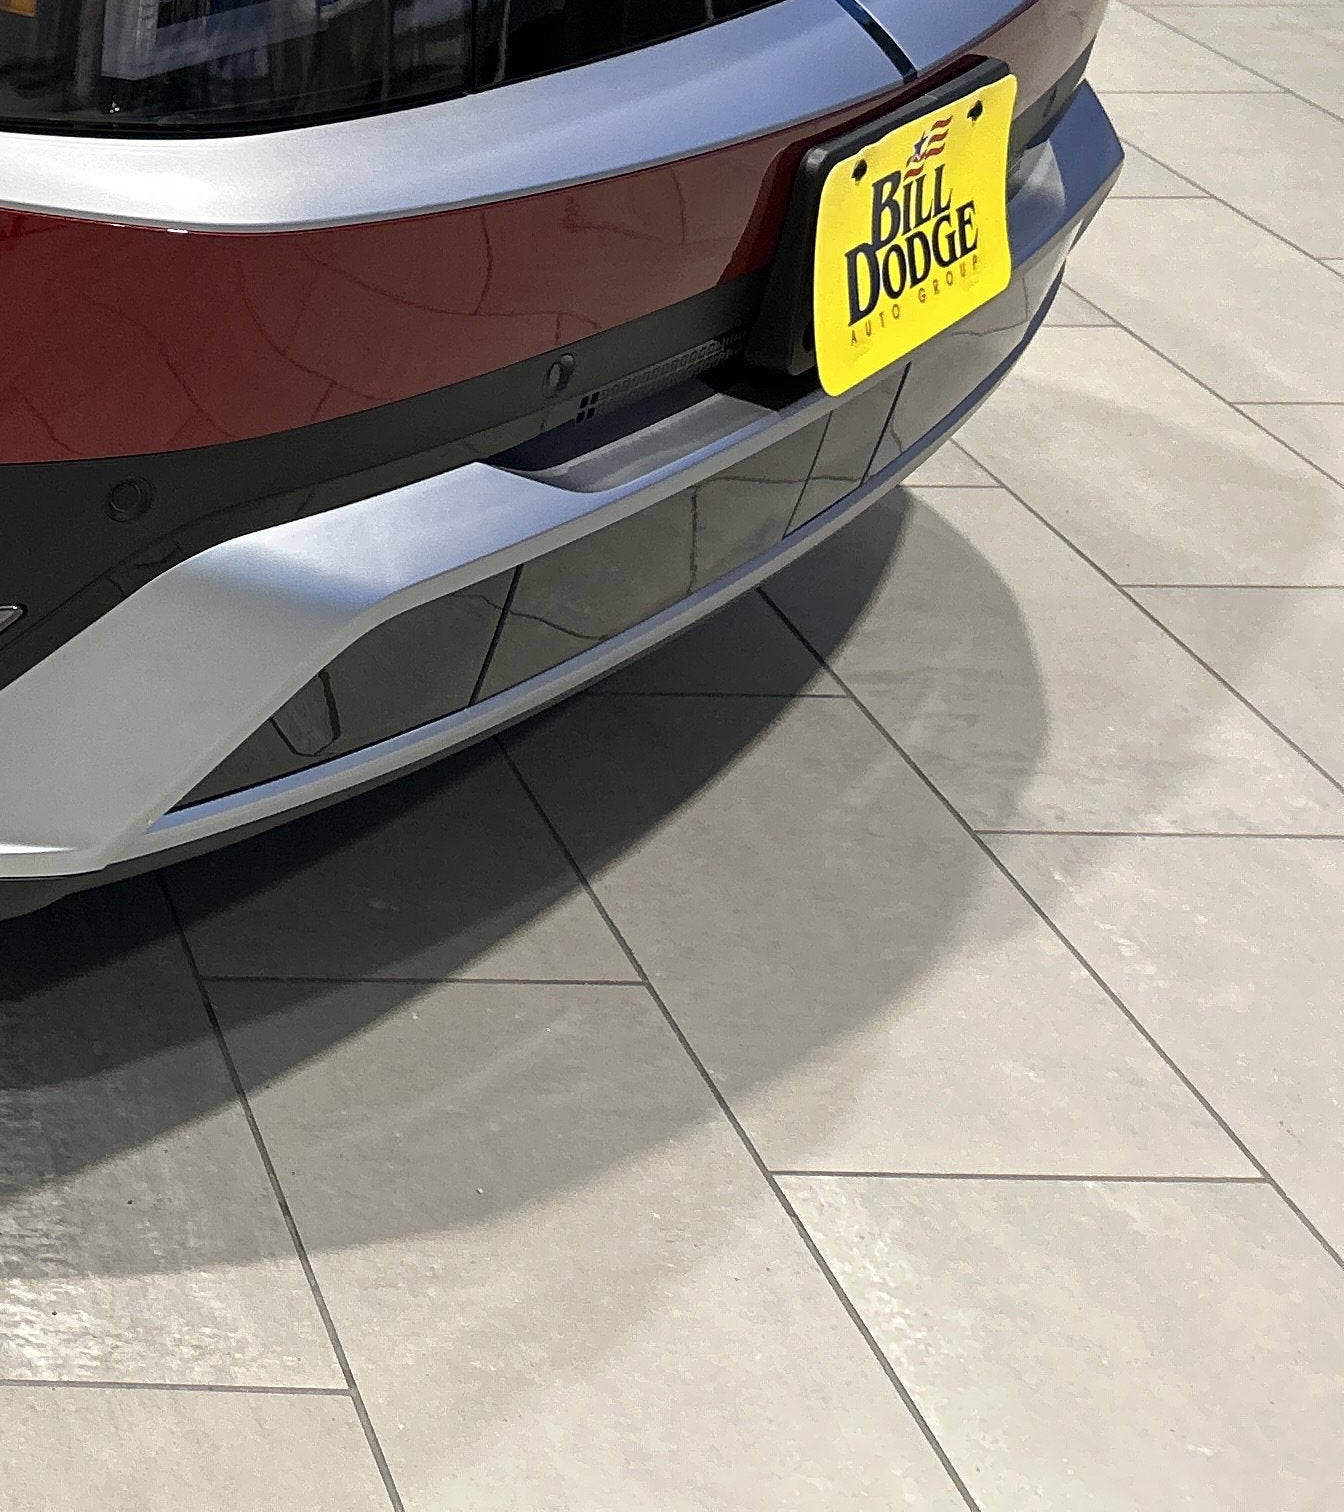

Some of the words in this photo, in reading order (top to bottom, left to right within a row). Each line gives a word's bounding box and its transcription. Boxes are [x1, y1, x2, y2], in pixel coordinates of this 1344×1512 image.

[872, 164, 953, 251] BILL
[845, 200, 978, 327] DODGE
[851, 303, 900, 346] AUTO
[917, 254, 979, 303] GROUP
